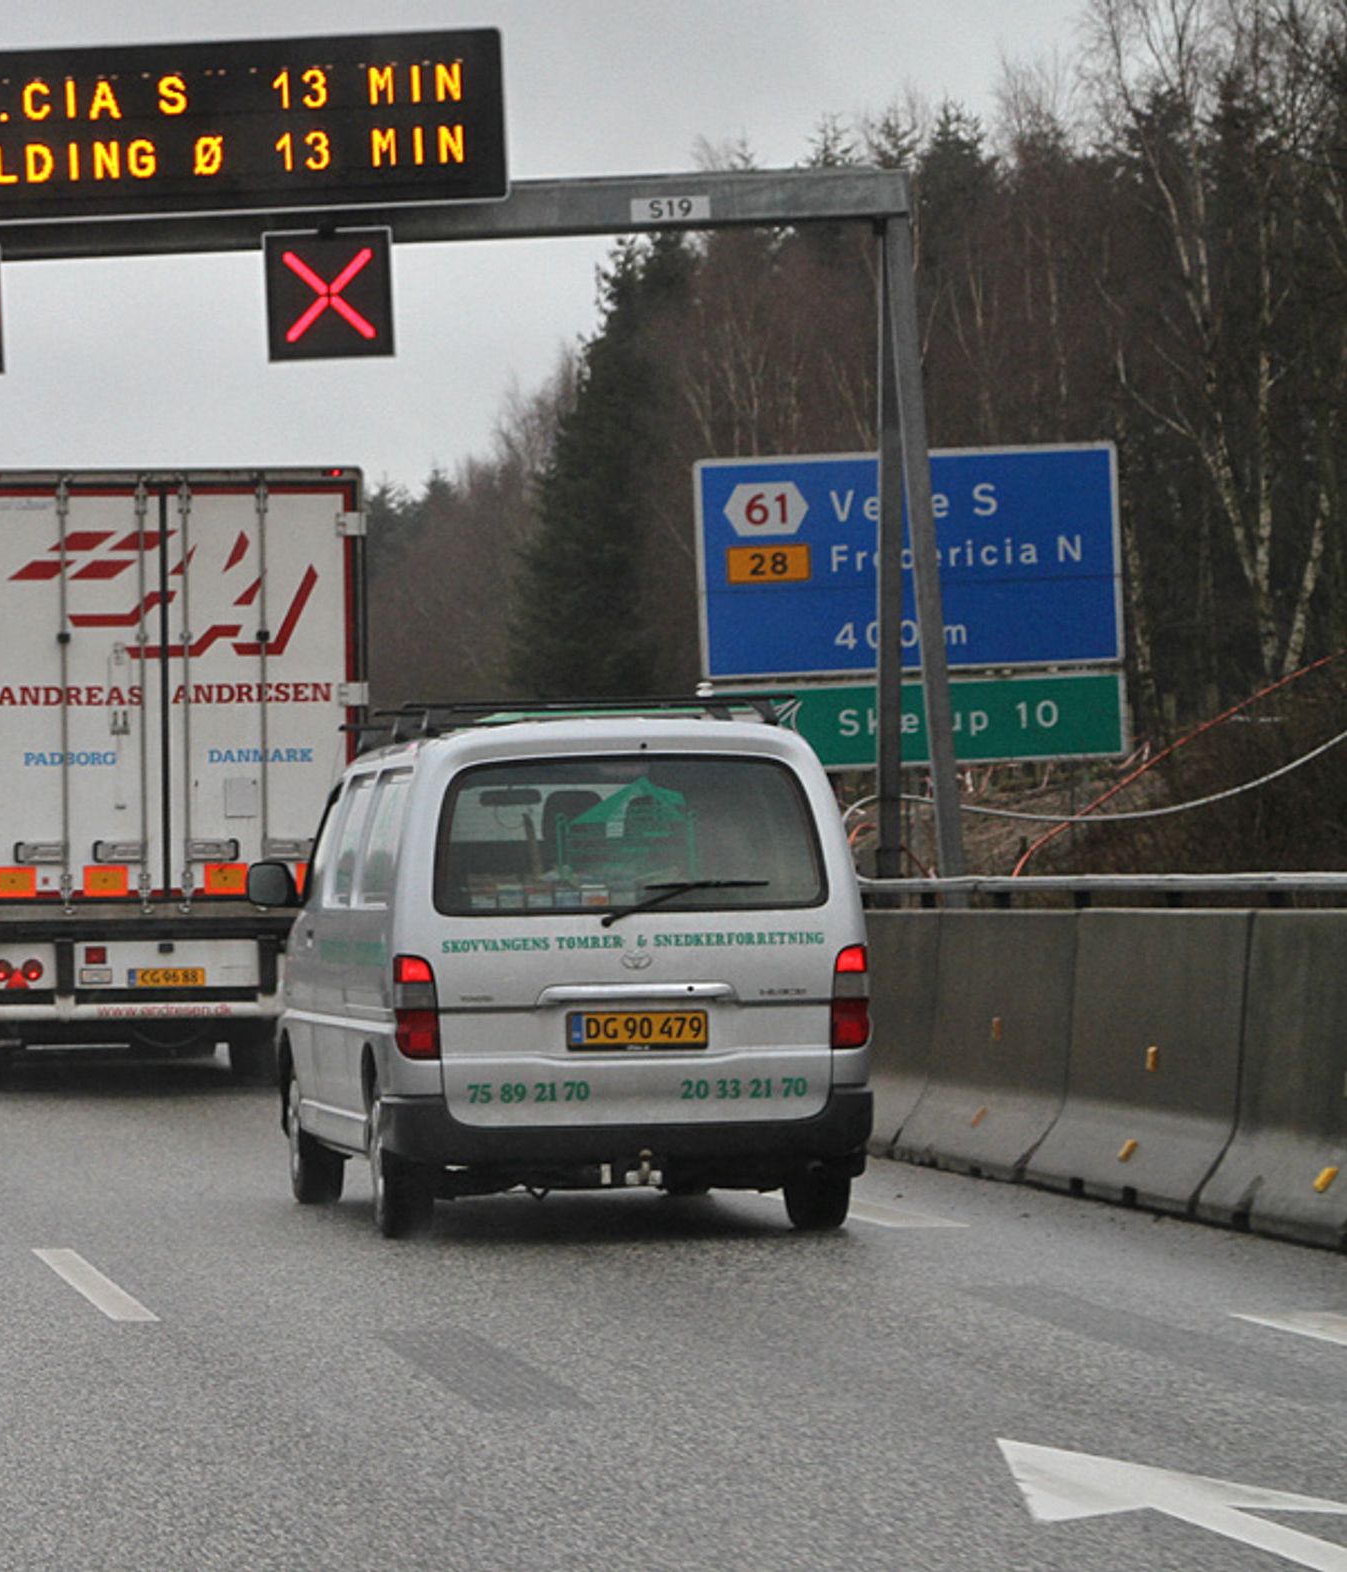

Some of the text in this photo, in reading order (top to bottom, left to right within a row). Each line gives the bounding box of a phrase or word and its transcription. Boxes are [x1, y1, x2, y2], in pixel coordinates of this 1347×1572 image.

[157, 75, 188, 115] S
[272, 68, 328, 110] 13
[368, 63, 462, 105] MIN
[193, 135, 223, 175] Ø
[275, 130, 331, 171] 13
[371, 125, 465, 168] MIN
[649, 198, 693, 219] S19
[745, 493, 789, 526] 61
[829, 482, 999, 522] Vee S
[1057, 534, 1082, 563] N
[749, 552, 789, 576] 28
[172, 682, 332, 704] ANDRESEN
[1016, 700, 1059, 729] 10
[24, 751, 117, 767] PADBORG
[208, 748, 314, 764] DANMARK
[442, 936, 551, 953] SKOVVANGENS
[637, 934, 648, 948] &
[653, 931, 825, 947] SNEDKERFORRETNING
[585, 1016, 703, 1039] DG 90 479
[467, 1081, 590, 1104] 75 89 21 70
[681, 1077, 808, 1099] 20 33 21 70
